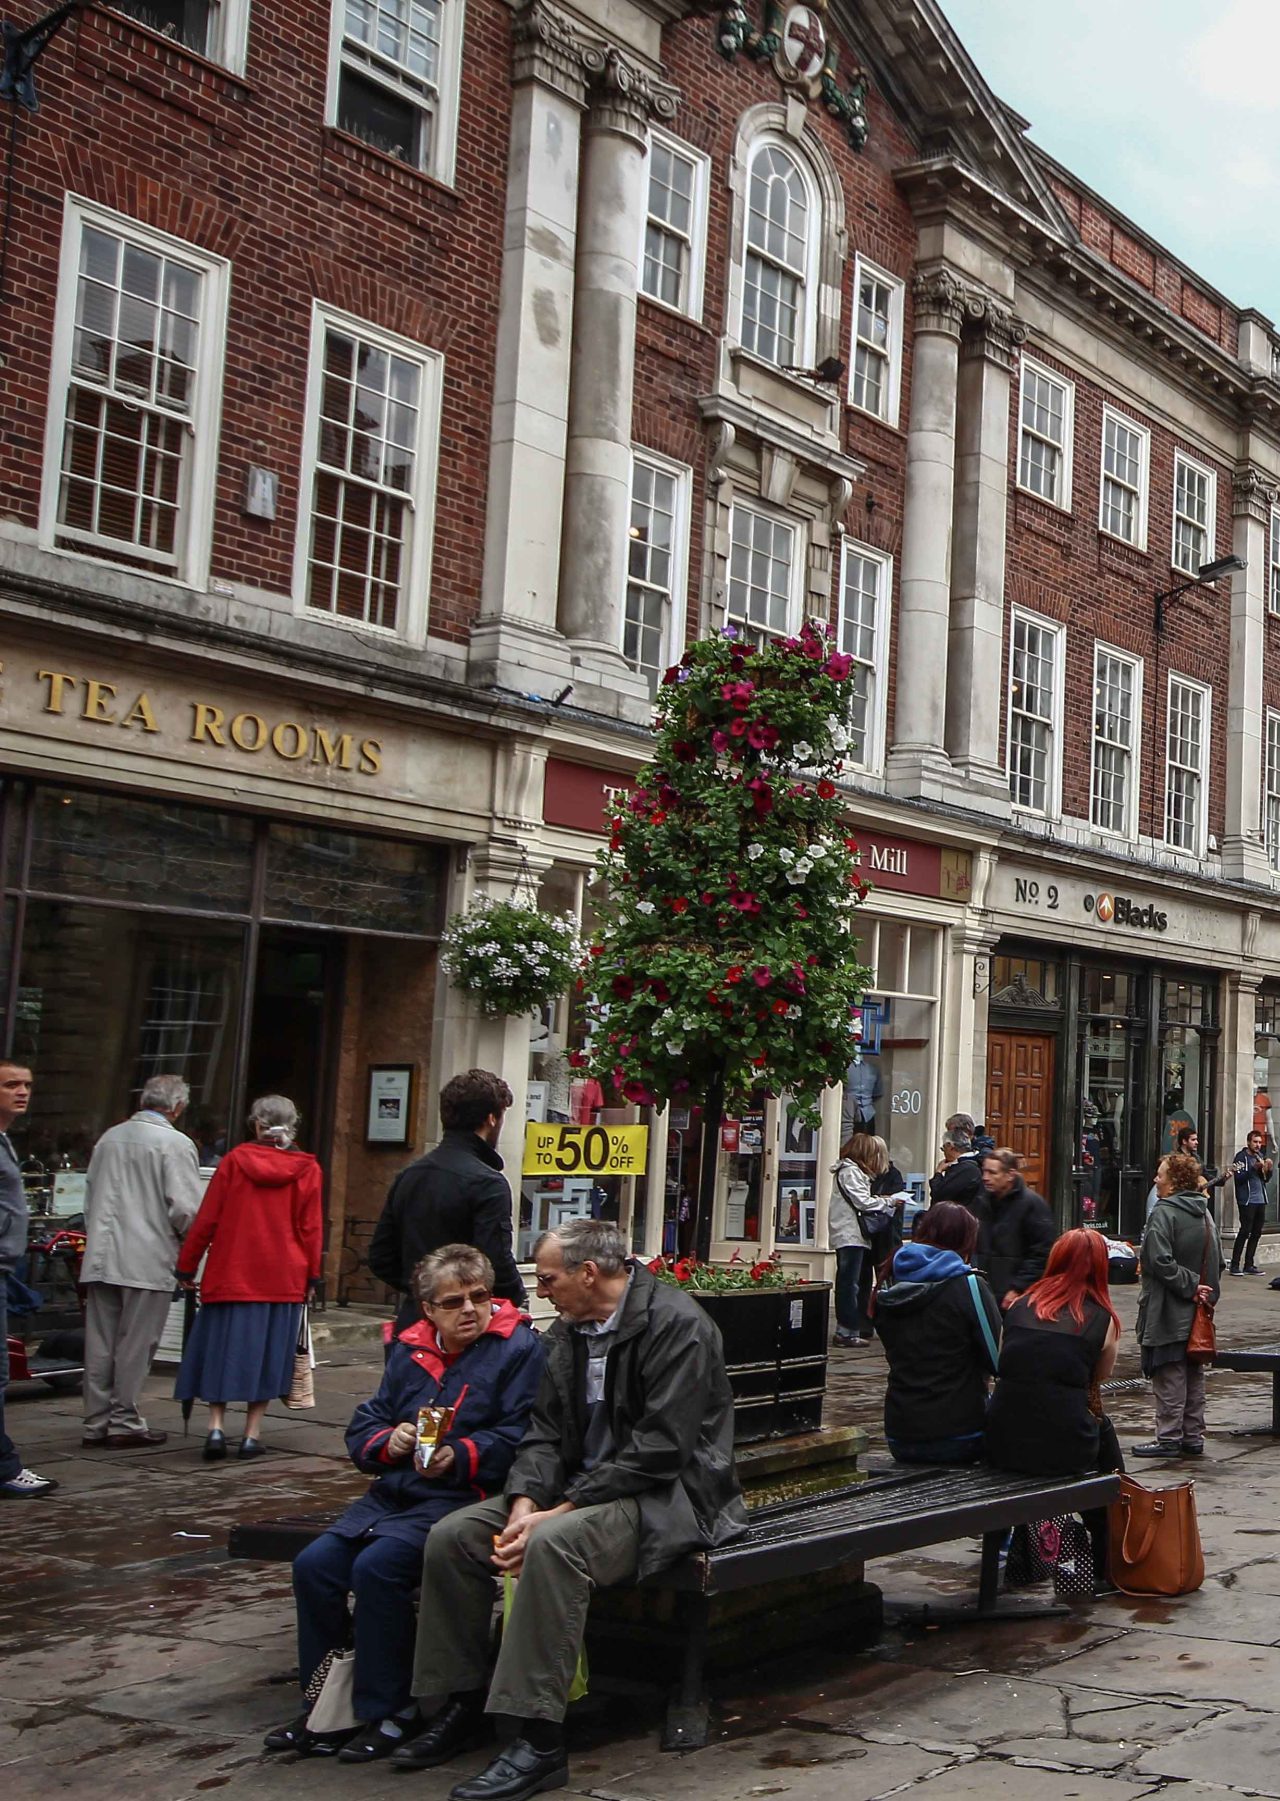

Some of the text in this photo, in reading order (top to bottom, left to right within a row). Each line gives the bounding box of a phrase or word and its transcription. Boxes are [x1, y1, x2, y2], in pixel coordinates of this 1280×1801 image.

[37, 669, 161, 733] TEA
[190, 702, 384, 776] ROOMS
[1047, 885, 1059, 910] 2
[1113, 896, 1168, 932] Blacks
[891, 1089, 921, 1114] £30
[537, 1136, 555, 1149] UP
[536, 1152, 553, 1165] TO
[609, 1155, 635, 1169] OFF
